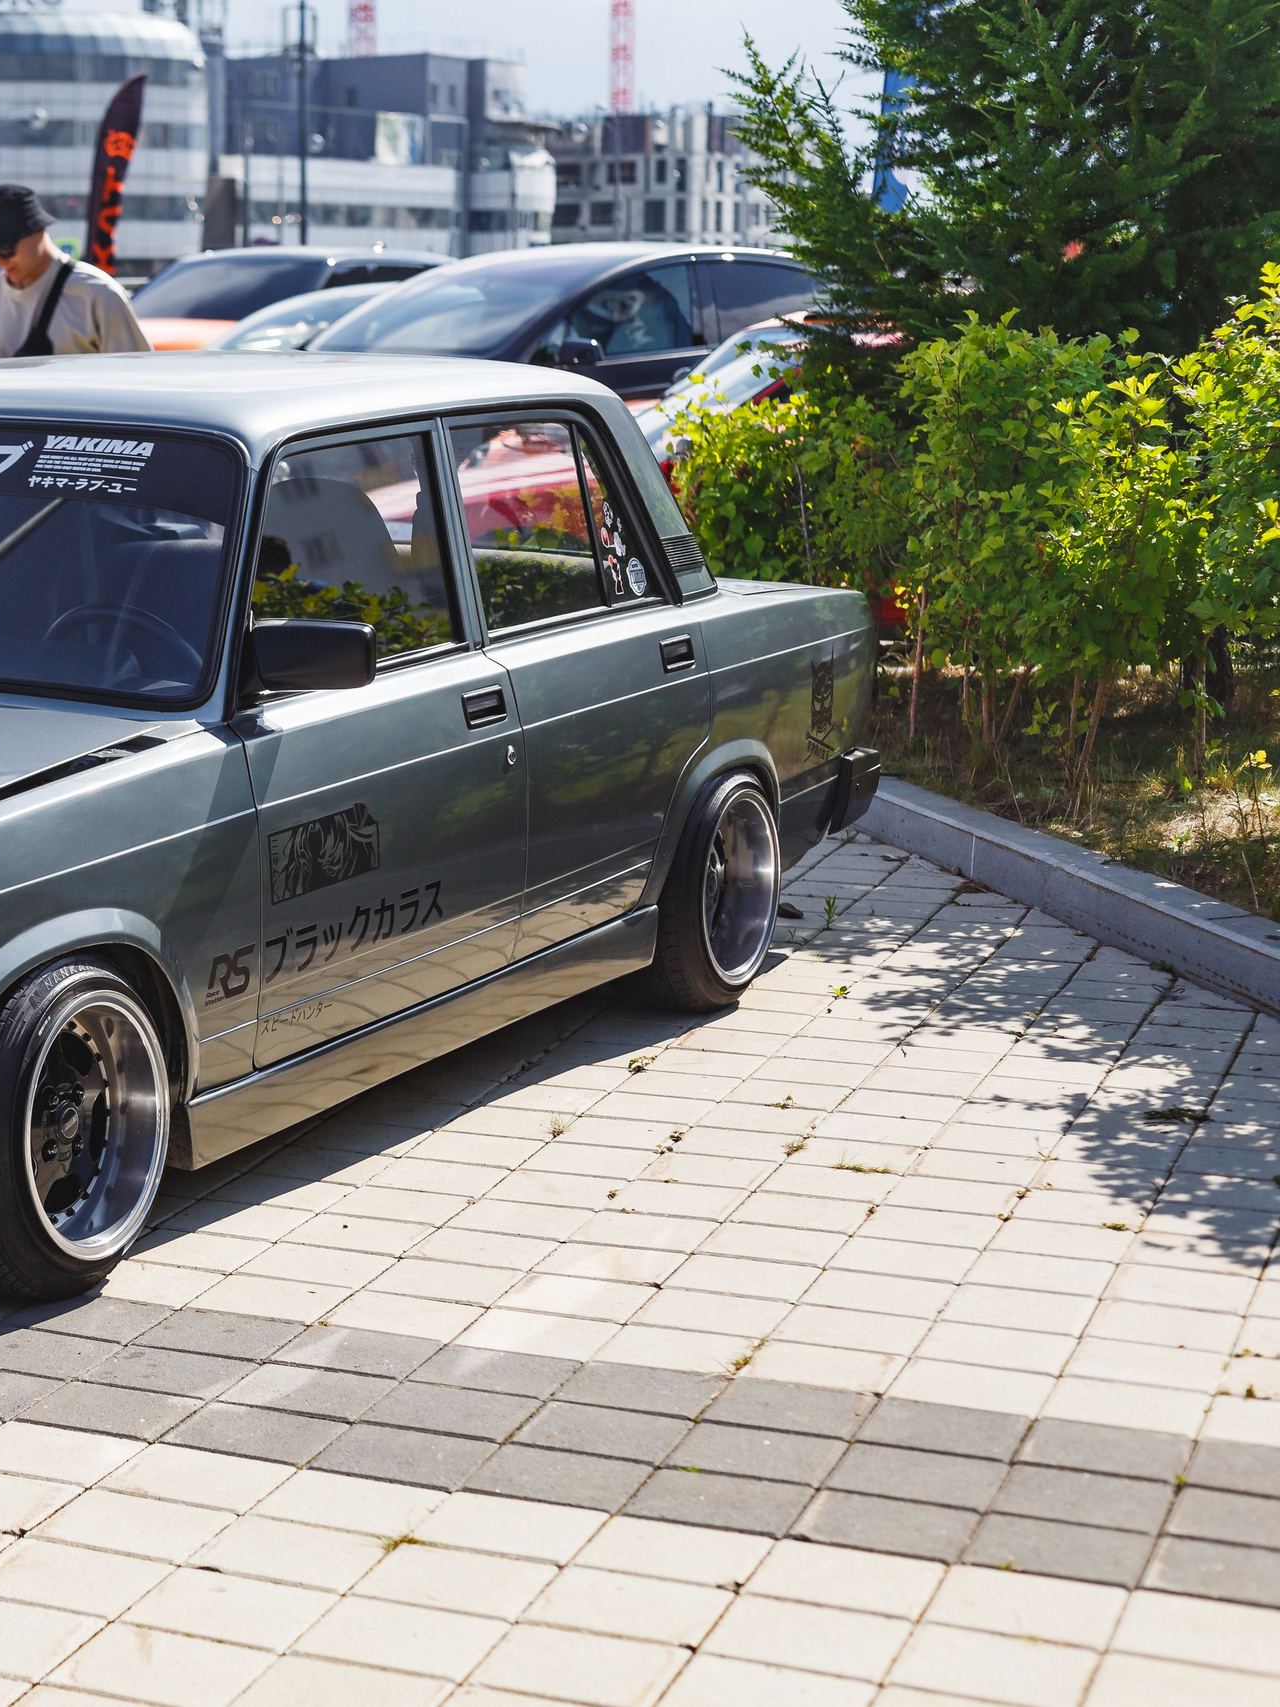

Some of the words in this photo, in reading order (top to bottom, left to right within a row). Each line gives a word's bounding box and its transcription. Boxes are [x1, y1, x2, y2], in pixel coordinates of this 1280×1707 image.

[43, 435, 155, 457] YAKIMA
[264, 880, 444, 984] ブラックカラス
[207, 942, 256, 999] RS
